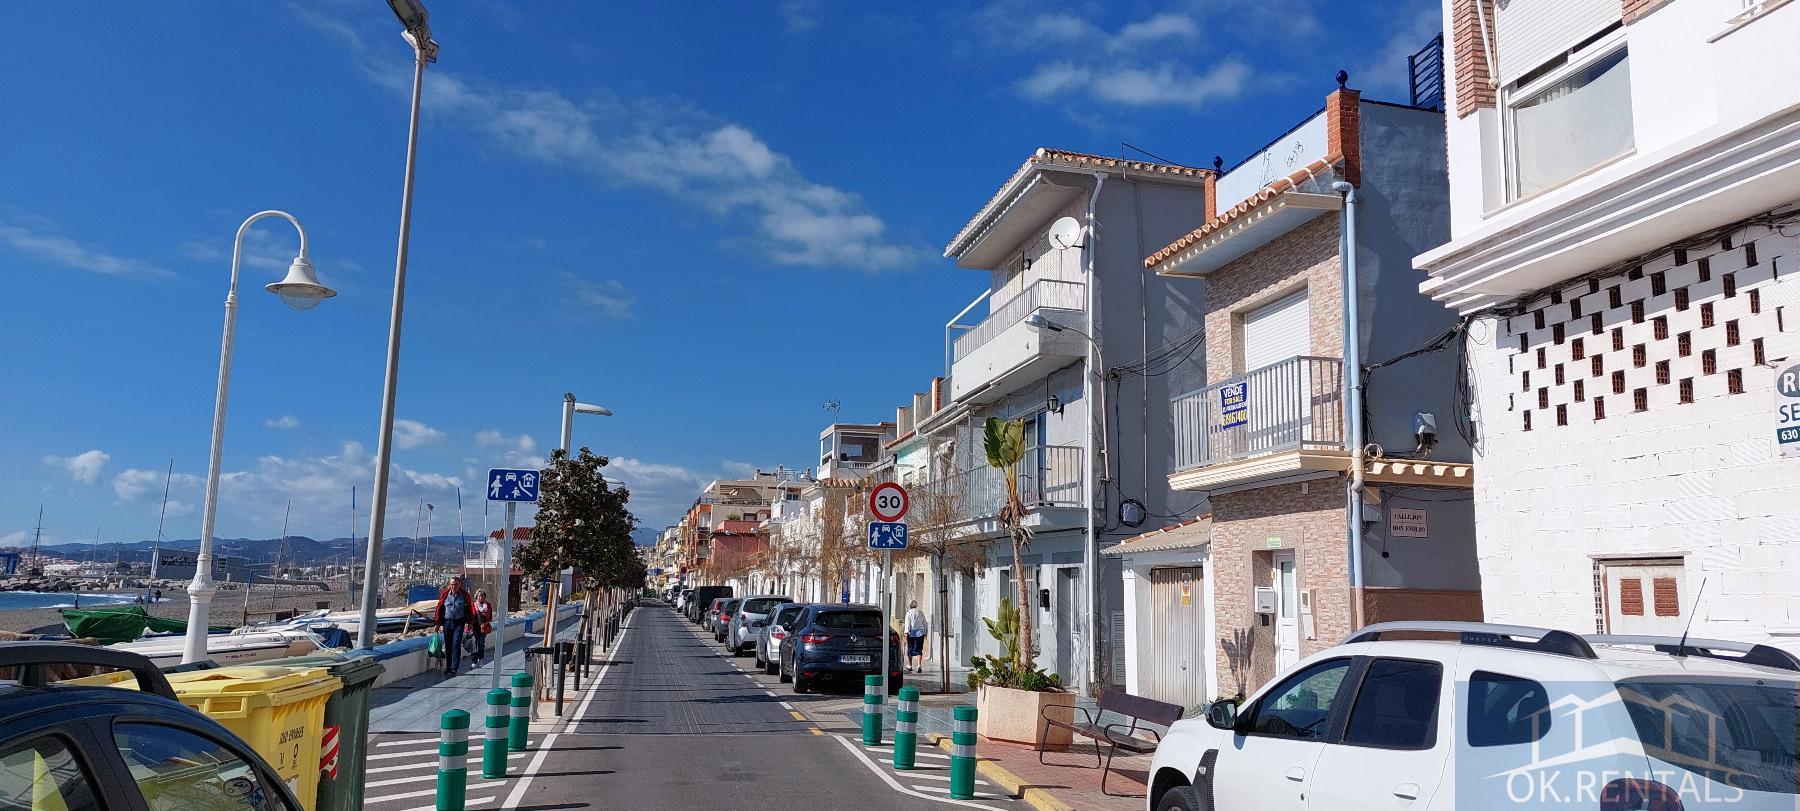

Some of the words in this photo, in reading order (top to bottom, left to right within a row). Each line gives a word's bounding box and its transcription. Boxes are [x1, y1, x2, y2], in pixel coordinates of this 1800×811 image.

[1783, 371, 1800, 394] R
[1223, 385, 1244, 398] VENDE
[1224, 397, 1233, 406] FOR
[1233, 395, 1244, 403] SALE
[1781, 429, 1799, 441] 630
[878, 495, 901, 509] 30
